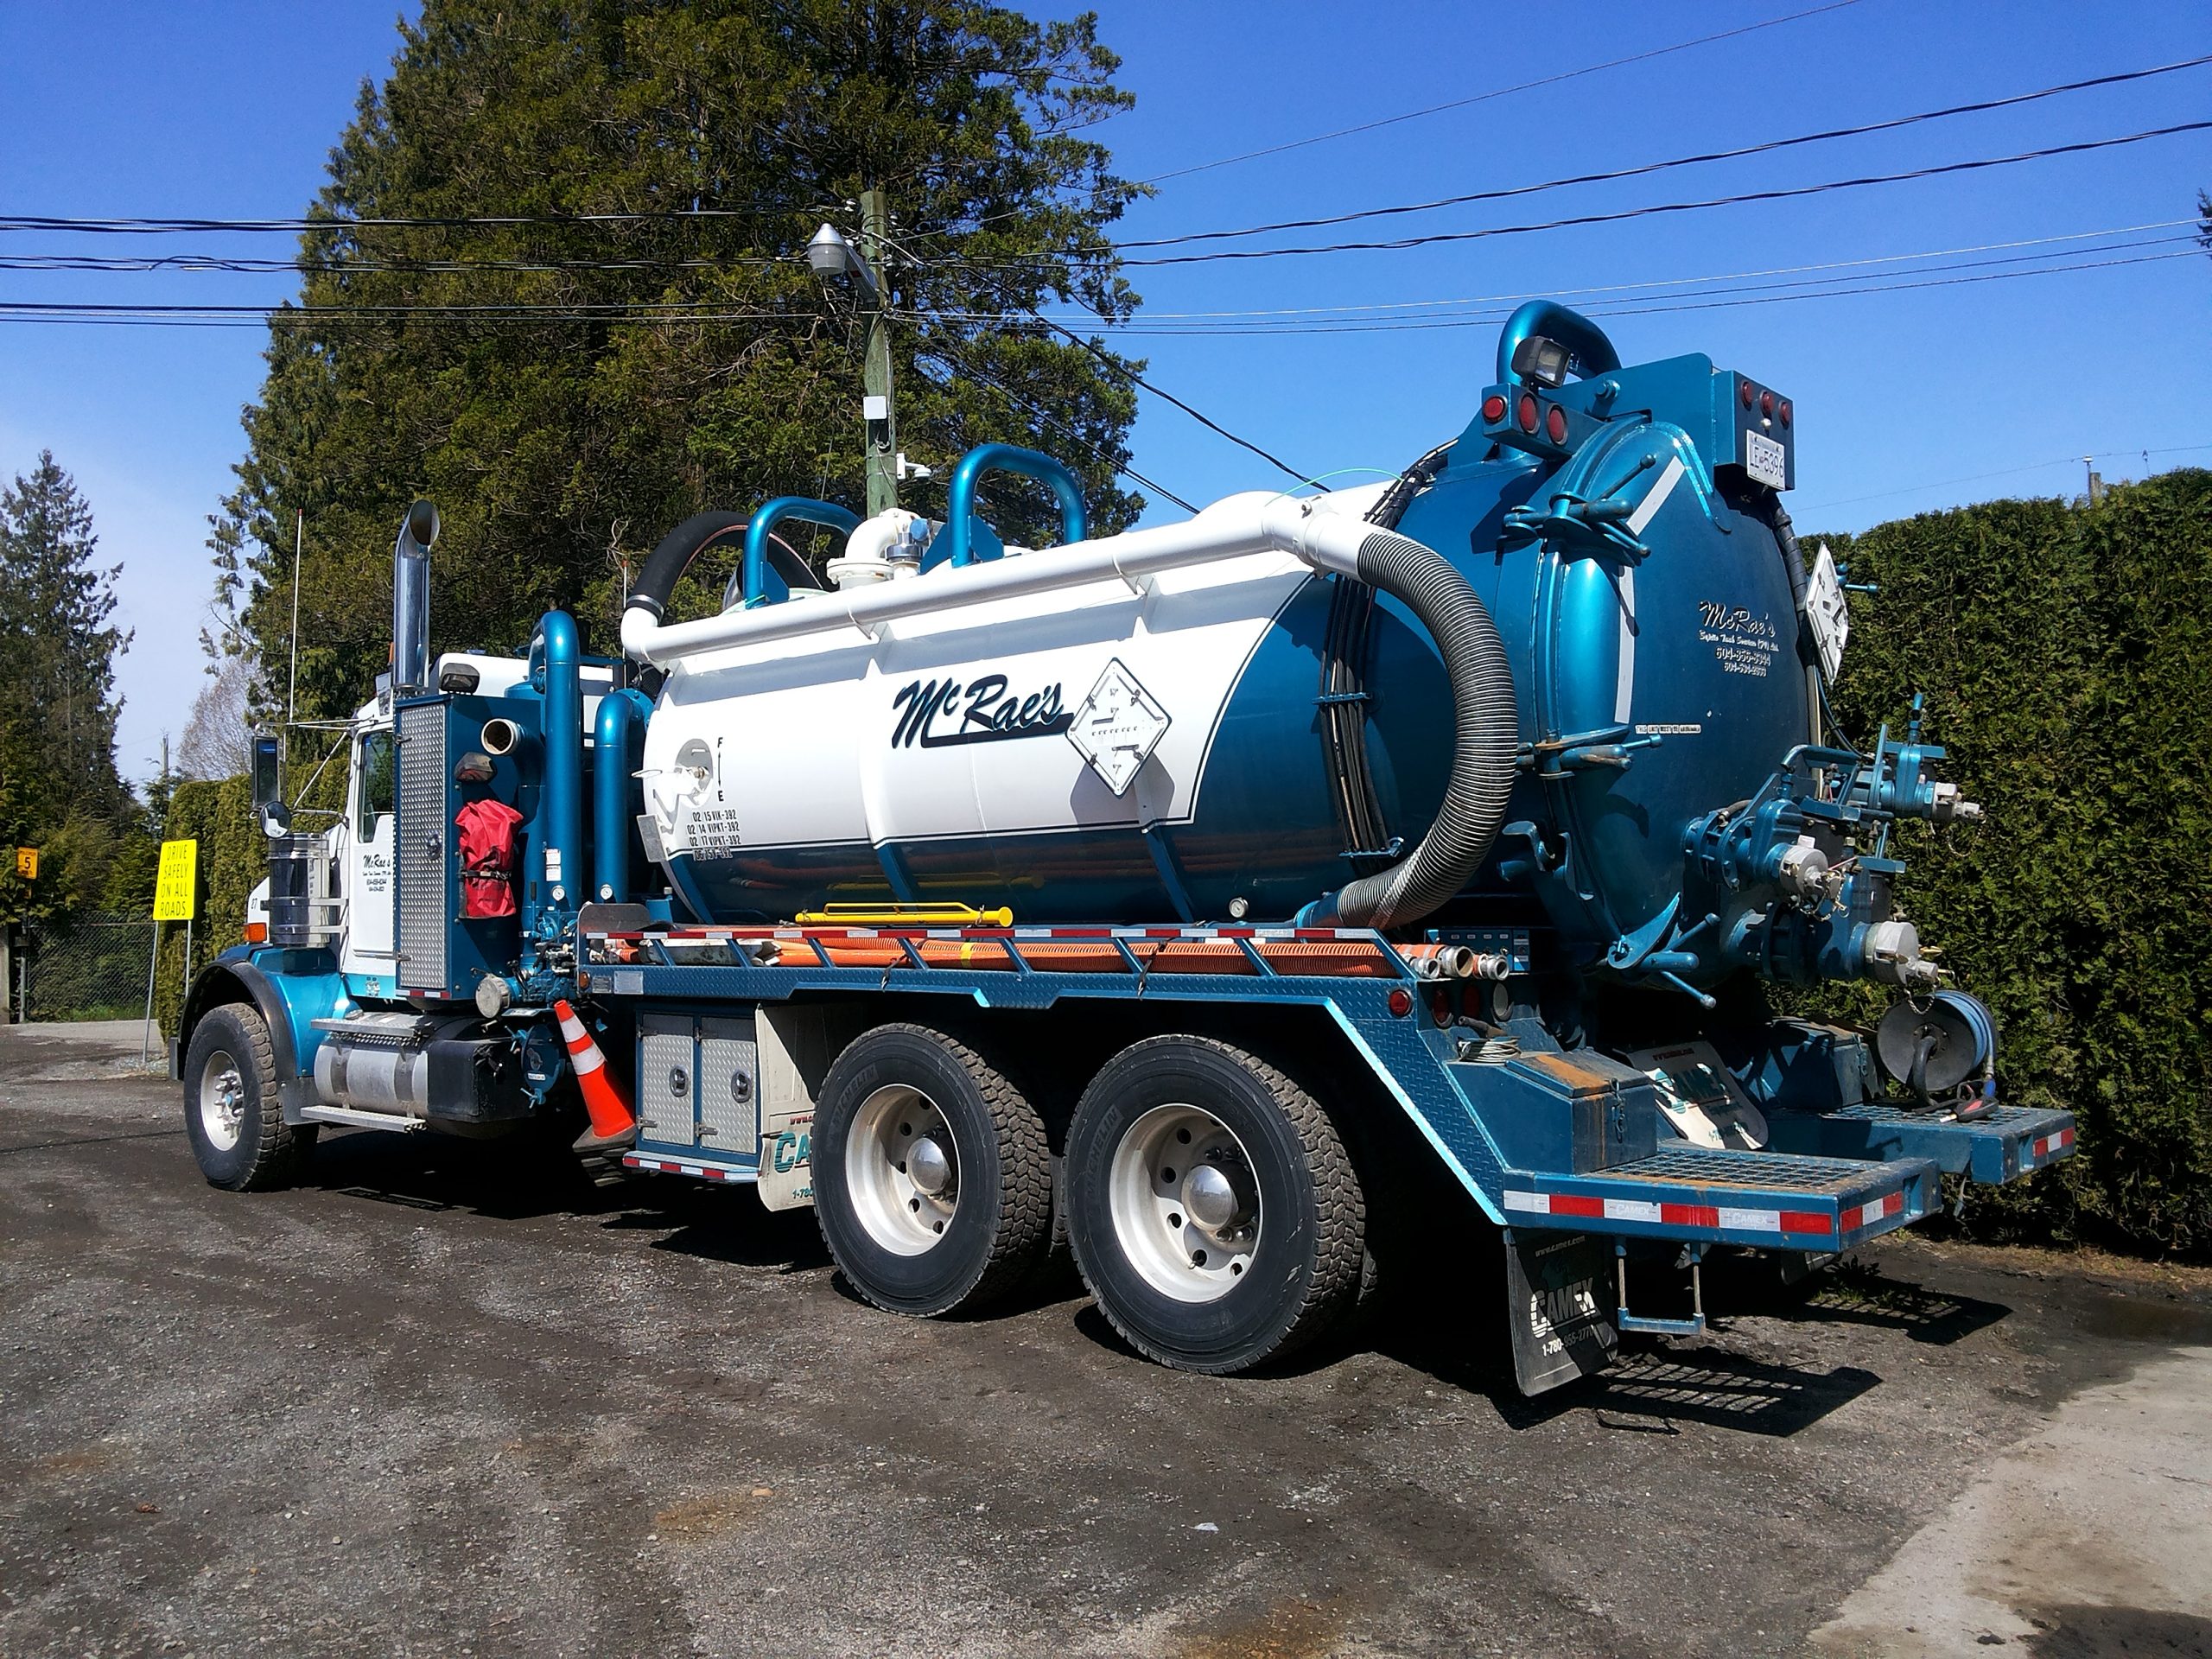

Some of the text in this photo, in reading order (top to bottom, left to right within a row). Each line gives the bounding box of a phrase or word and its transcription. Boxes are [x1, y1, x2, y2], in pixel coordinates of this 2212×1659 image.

[1699, 601, 1776, 638] McRae's
[892, 674, 1073, 749] McRae's
[717, 736, 723, 748] F
[718, 790, 724, 802] E
[692, 811, 702, 822] 02
[687, 824, 696, 835] 02
[698, 823, 706, 834] 14
[689, 836, 698, 847] 02
[701, 835, 708, 846] 17
[167, 844, 188, 861] DRIVE
[24, 856, 31, 869] 5
[163, 863, 189, 880] SAFELY
[161, 882, 188, 898] ON ALL
[160, 900, 187, 917] ROADS
[1530, 1276, 1598, 1339] CAMEX
